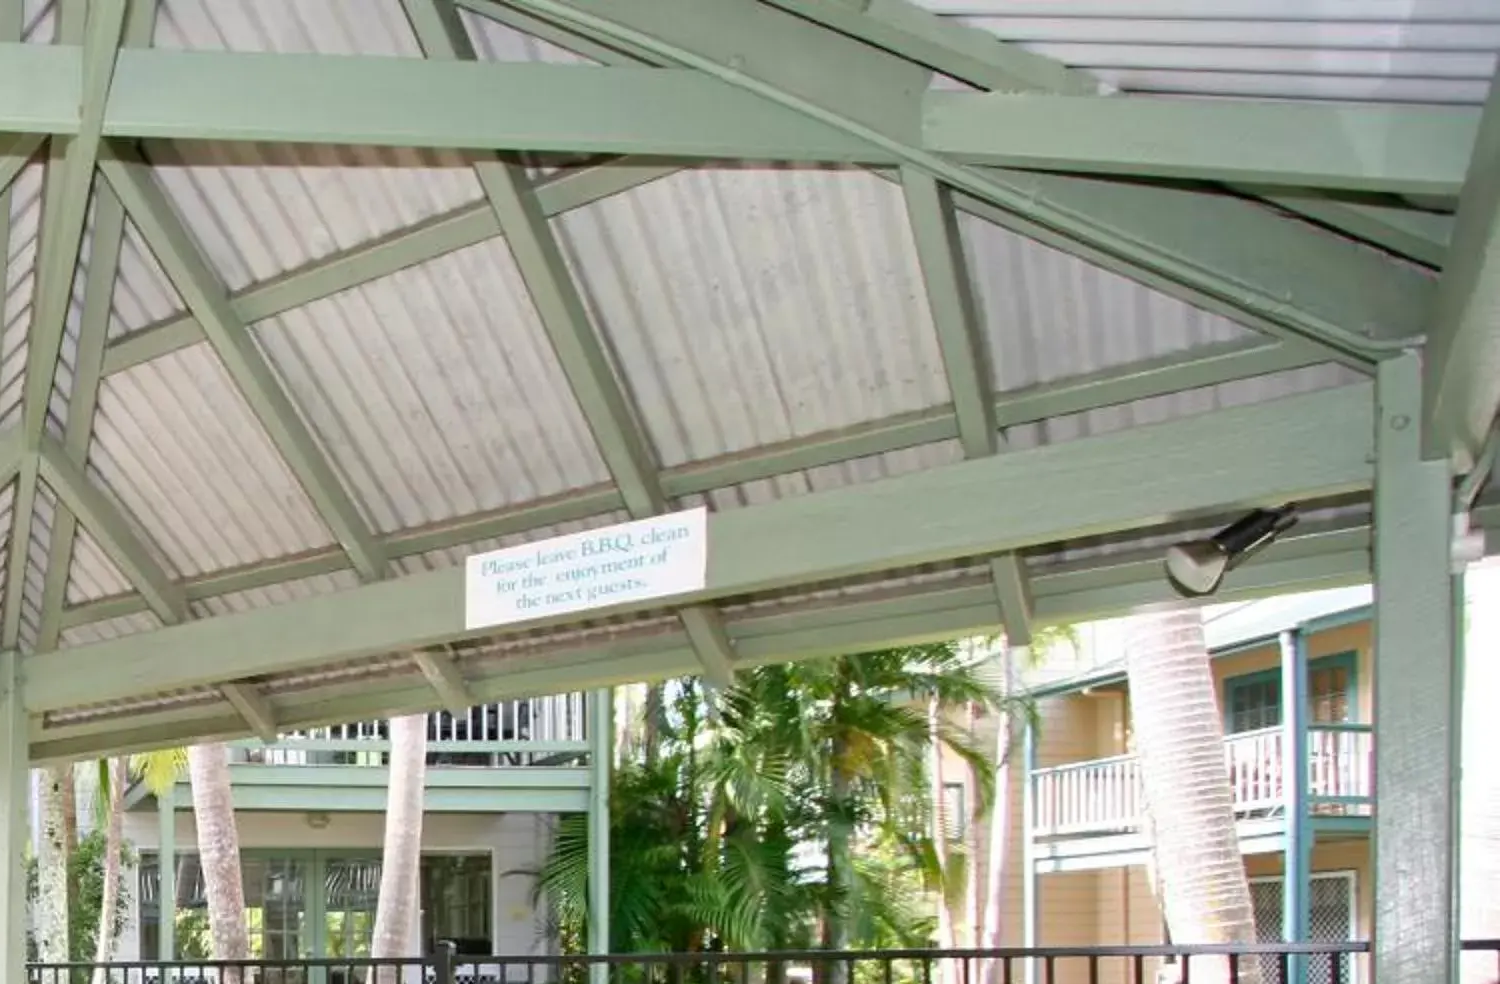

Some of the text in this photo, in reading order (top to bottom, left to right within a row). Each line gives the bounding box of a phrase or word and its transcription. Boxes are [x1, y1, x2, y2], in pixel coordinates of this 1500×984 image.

[481, 559, 529, 577] Please
[537, 549, 577, 567] leave
[641, 526, 690, 545] clean
[496, 545, 670, 594] for the enjoyment of
[515, 593, 542, 609] the
[545, 587, 583, 605] next
